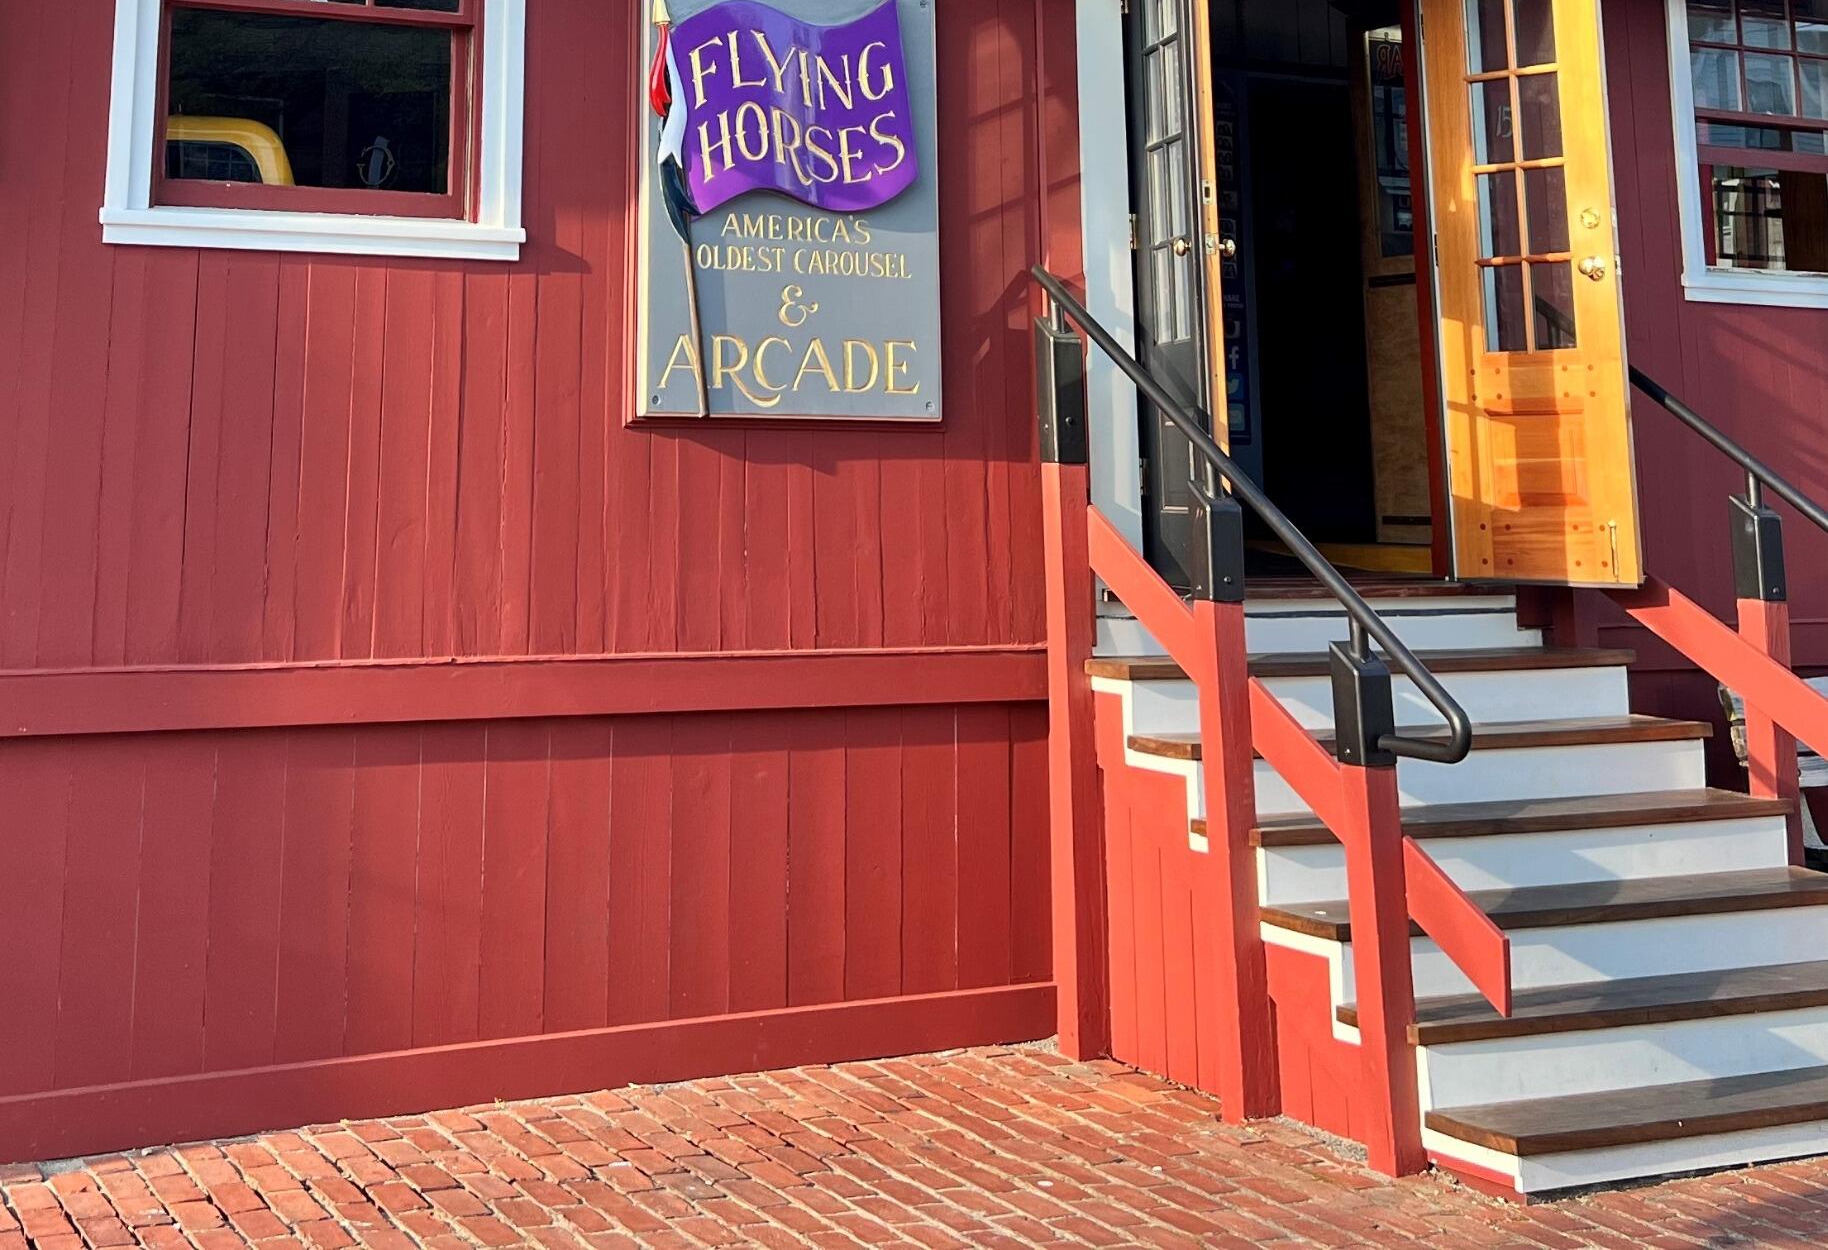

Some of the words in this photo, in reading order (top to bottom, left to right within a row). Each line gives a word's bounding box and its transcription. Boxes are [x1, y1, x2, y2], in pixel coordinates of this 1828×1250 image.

[689, 29, 894, 110] FLYING
[697, 101, 905, 186] HORSES
[720, 213, 871, 245] AMERICA'S
[696, 244, 785, 272] OLDEST
[794, 249, 912, 279] CAROUSEL
[778, 284, 819, 327] &
[657, 334, 921, 408] ARCADE
